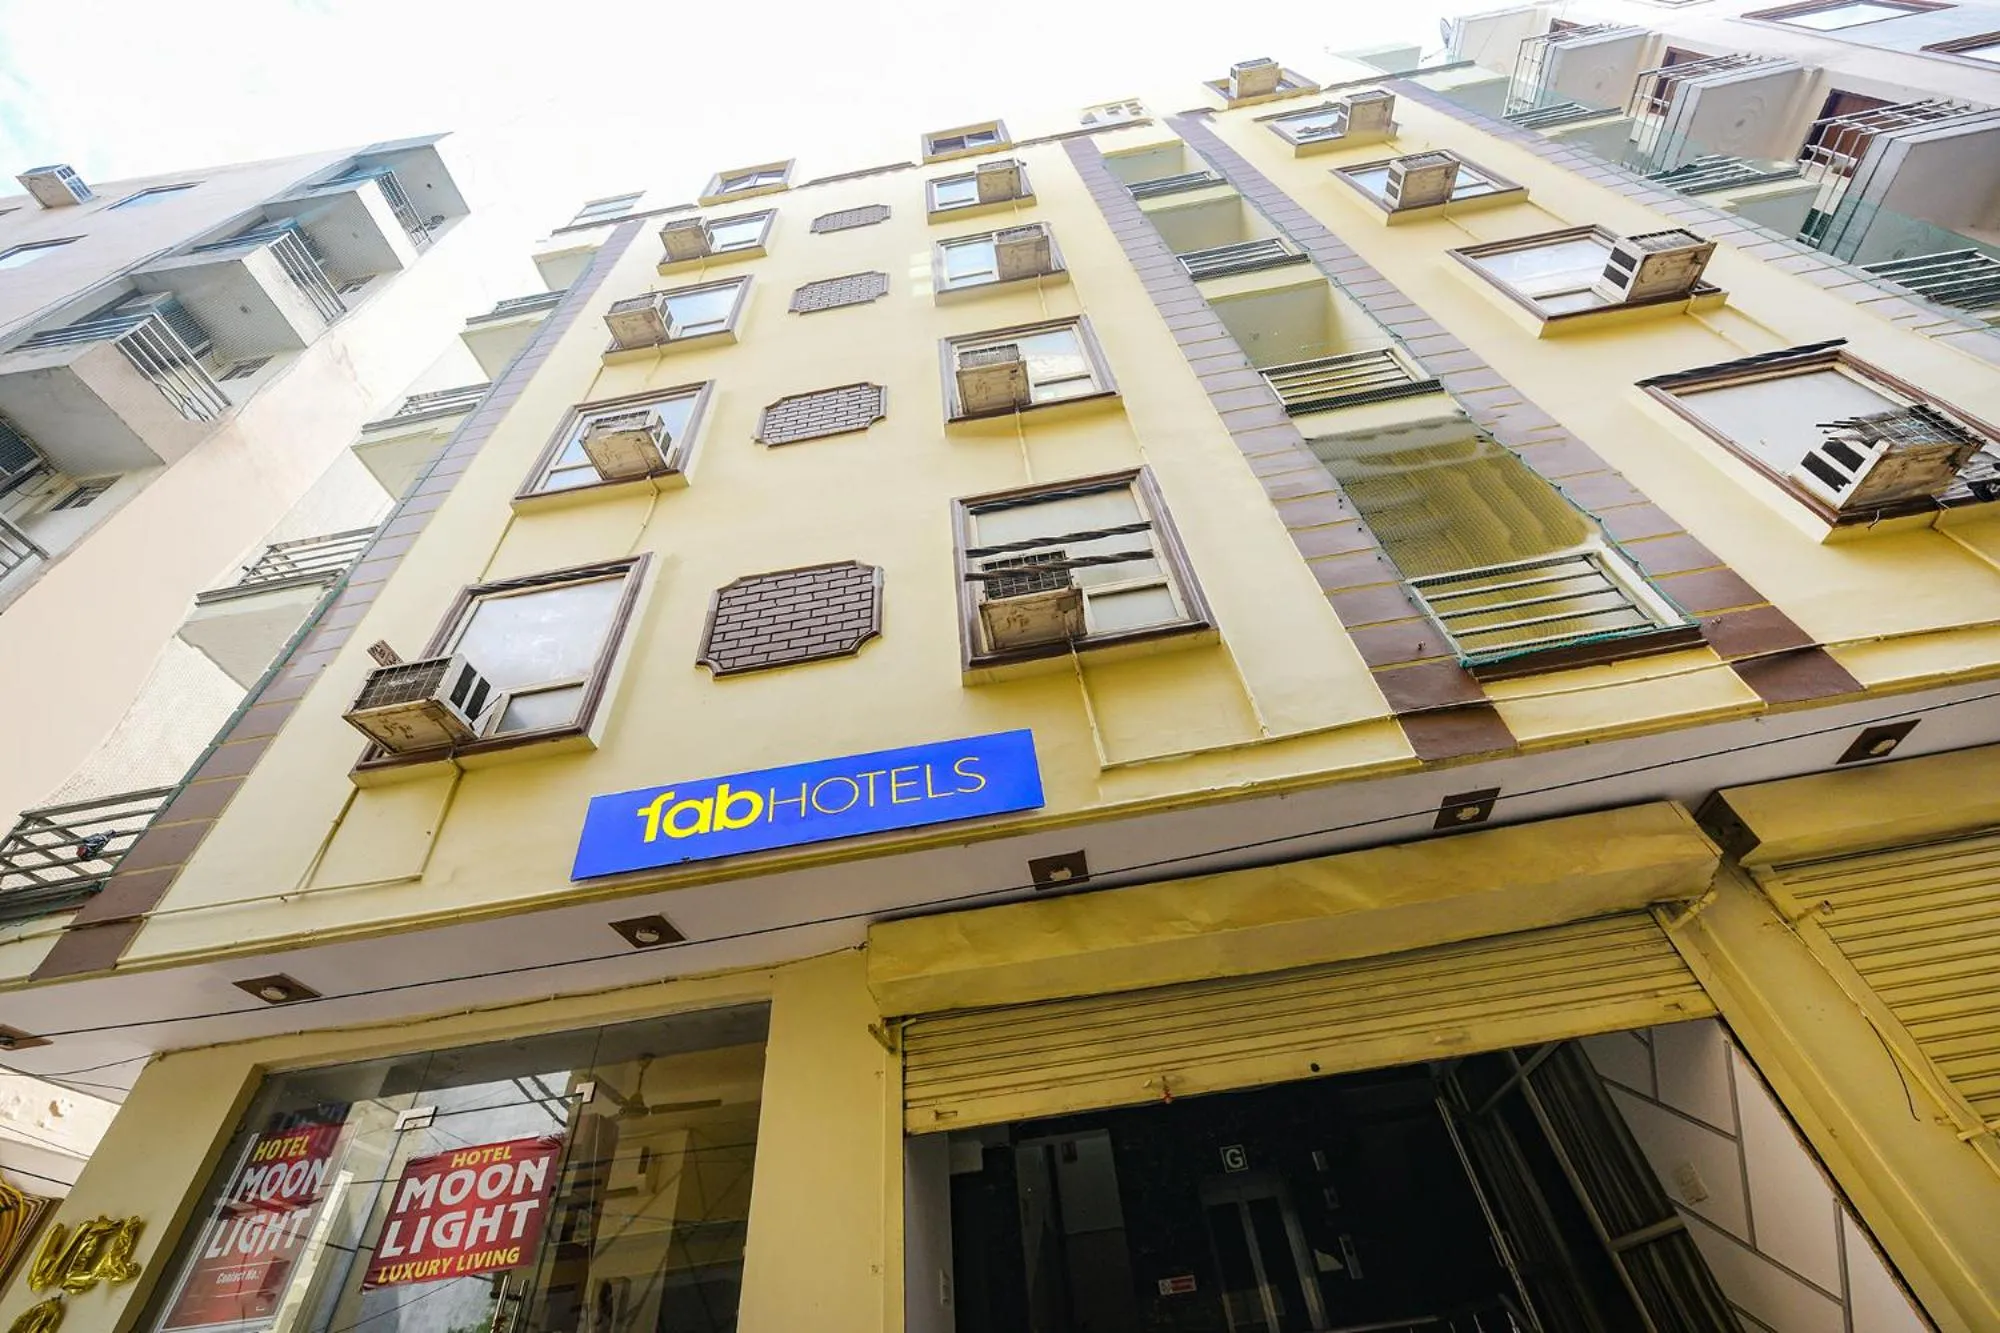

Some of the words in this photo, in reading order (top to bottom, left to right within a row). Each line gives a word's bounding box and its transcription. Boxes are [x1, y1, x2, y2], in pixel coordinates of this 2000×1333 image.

[253, 1136, 310, 1160] HOTEL
[451, 1145, 512, 1169] HOTEL
[1226, 1149, 1243, 1168] G
[236, 1157, 332, 1203] MOON
[396, 1157, 550, 1213] MOON
[205, 1208, 311, 1259] LIGHT
[379, 1200, 540, 1259] LIGHT
[378, 1256, 452, 1284] LUXURY
[456, 1246, 520, 1273] LIVING
